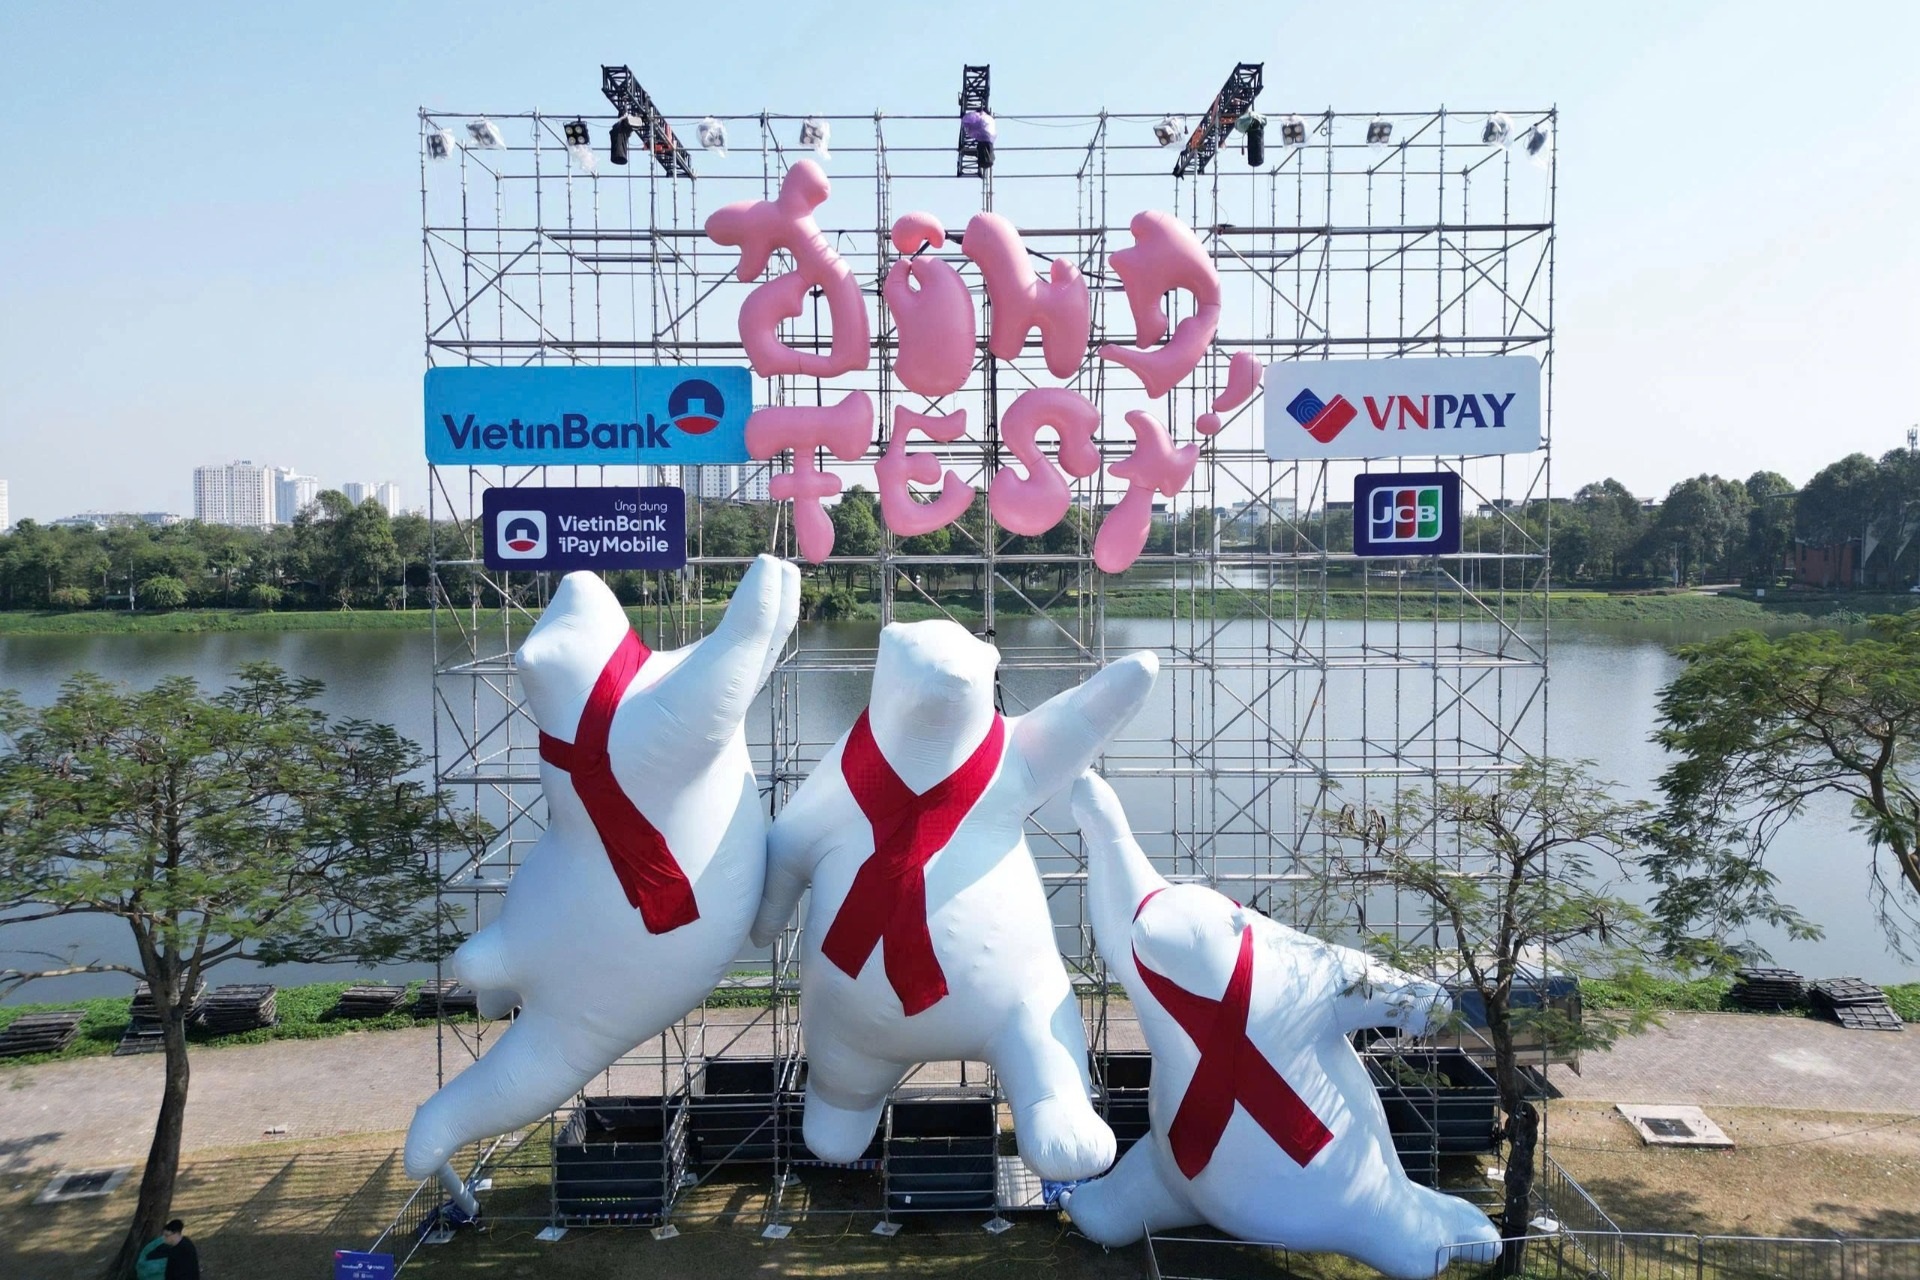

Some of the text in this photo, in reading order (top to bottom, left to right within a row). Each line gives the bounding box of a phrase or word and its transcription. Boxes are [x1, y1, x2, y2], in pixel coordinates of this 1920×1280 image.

[1363, 393, 1516, 431] VNPAY
[442, 413, 671, 450] VietinBank
[614, 499, 668, 514] Ứng dụng
[1372, 505, 1437, 524] JCB
[558, 515, 667, 532] VietinBank
[602, 535, 669, 553] Mobile
